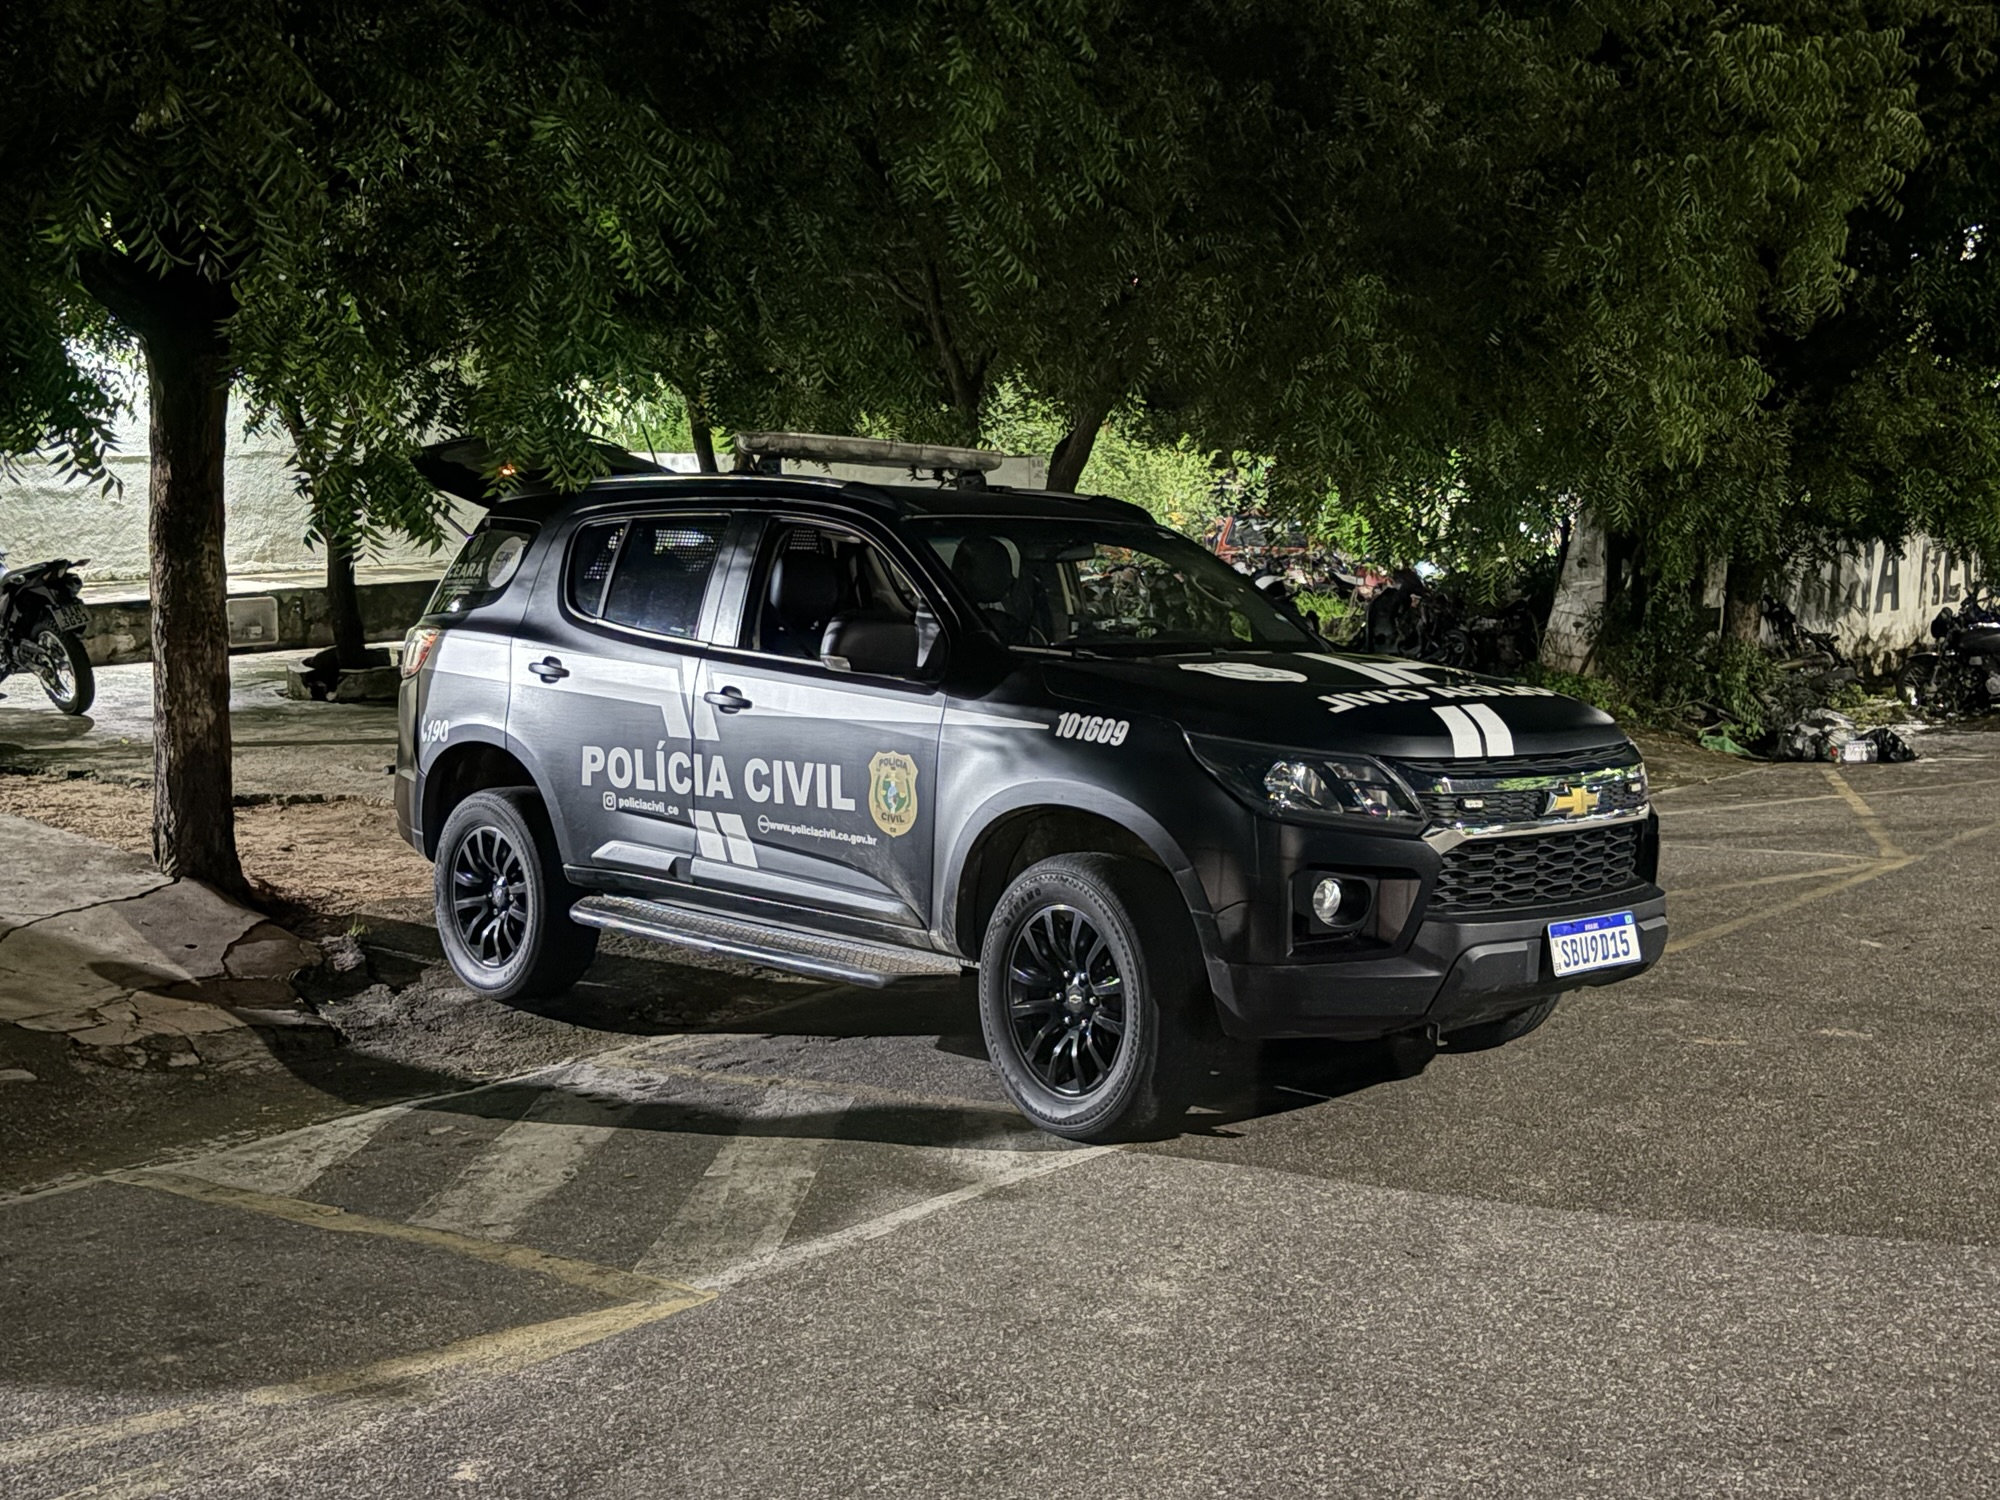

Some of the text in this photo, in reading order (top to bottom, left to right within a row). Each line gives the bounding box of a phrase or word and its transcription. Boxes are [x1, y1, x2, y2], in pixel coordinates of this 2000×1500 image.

[447, 557, 486, 579] CEARÁ
[427, 719, 449, 742] 190
[1055, 712, 1130, 746] 101609
[581, 740, 856, 811] POLÍCIA CIVIL
[618, 797, 679, 816] policiacivil_ce
[880, 812, 905, 823] CIVIL
[769, 821, 878, 846] www.policiacivil.ce.gov.br
[1003, 887, 1041, 927] DYNAMO
[1560, 929, 1631, 968] SBU9D15
